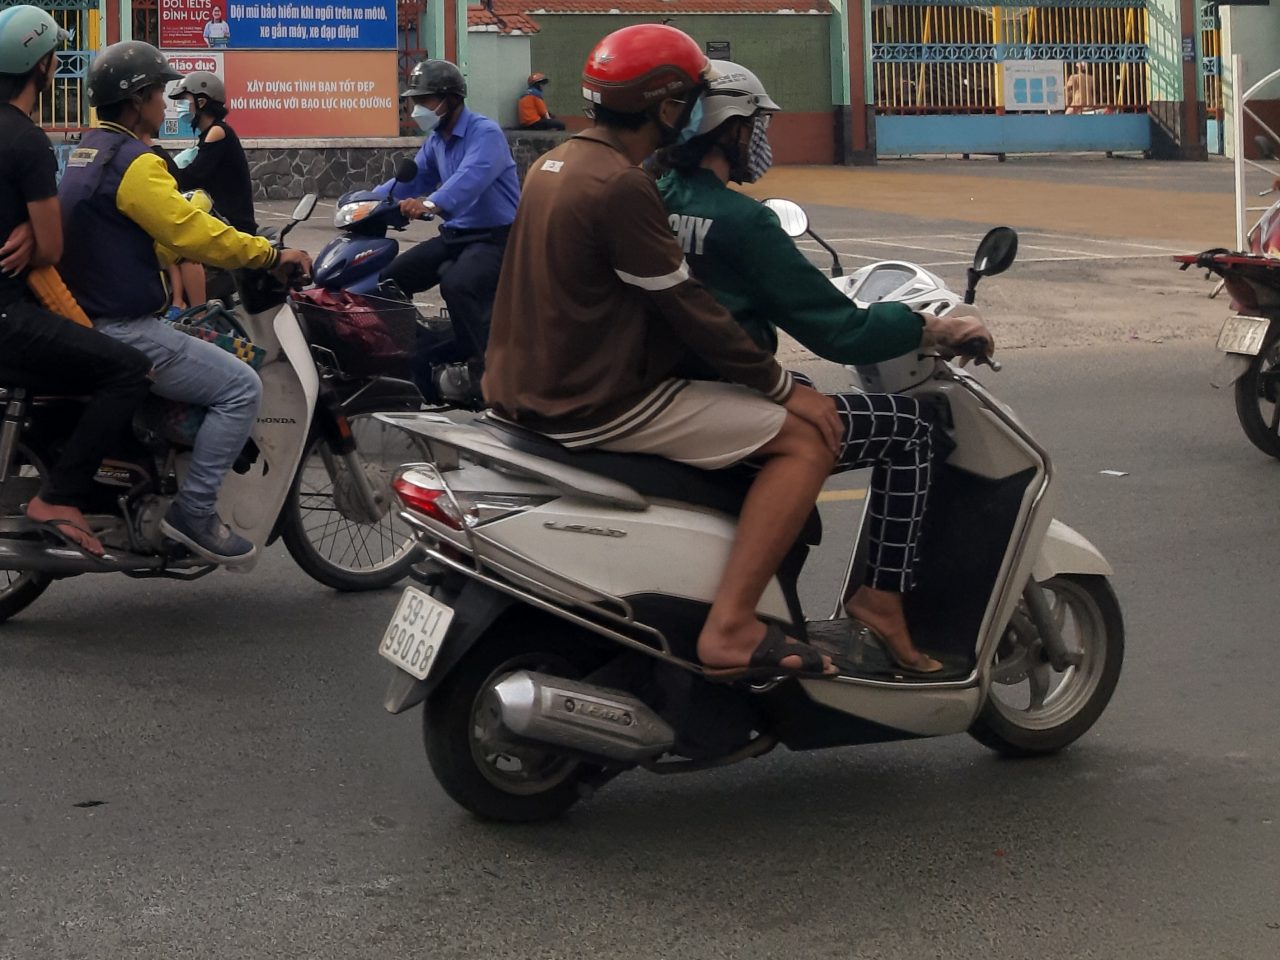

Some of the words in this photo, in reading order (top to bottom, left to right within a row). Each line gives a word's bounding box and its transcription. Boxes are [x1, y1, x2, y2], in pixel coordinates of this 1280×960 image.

[163, 8, 188, 20] ĐÌNH
[190, 10, 210, 22] LỰC
[246, 4, 259, 19] mũ
[260, 2, 276, 19] bảo
[278, 2, 300, 19] hiểm
[300, 5, 313, 19] khi
[315, 4, 334, 21] ngồi
[334, 6, 352, 19] trên
[353, 8, 363, 19] xe
[260, 26, 270, 37] xe
[271, 22, 287, 39] gắn
[288, 24, 309, 40] máy,
[309, 26, 319, 38] xe
[320, 25, 336, 41] đạp
[337, 25, 359, 41] điện!
[247, 79, 264, 93] XÂY
[265, 80, 292, 96] DỰNG
[293, 79, 316, 92] TÌNH
[318, 81, 337, 95] BẠN
[339, 78, 356, 92] TỐT
[357, 81, 375, 95] ĐẸP
[230, 96, 247, 109] NÓI
[249, 96, 282, 110] KHÔNG
[283, 97, 299, 109] VỚI
[301, 98, 320, 112] BẠO
[321, 97, 338, 112] LỰC
[340, 98, 358, 112] HỌC
[359, 96, 392, 109] ĐƯỜNG
[403, 595, 443, 638] 59-L1
[385, 623, 434, 672] 990.68
